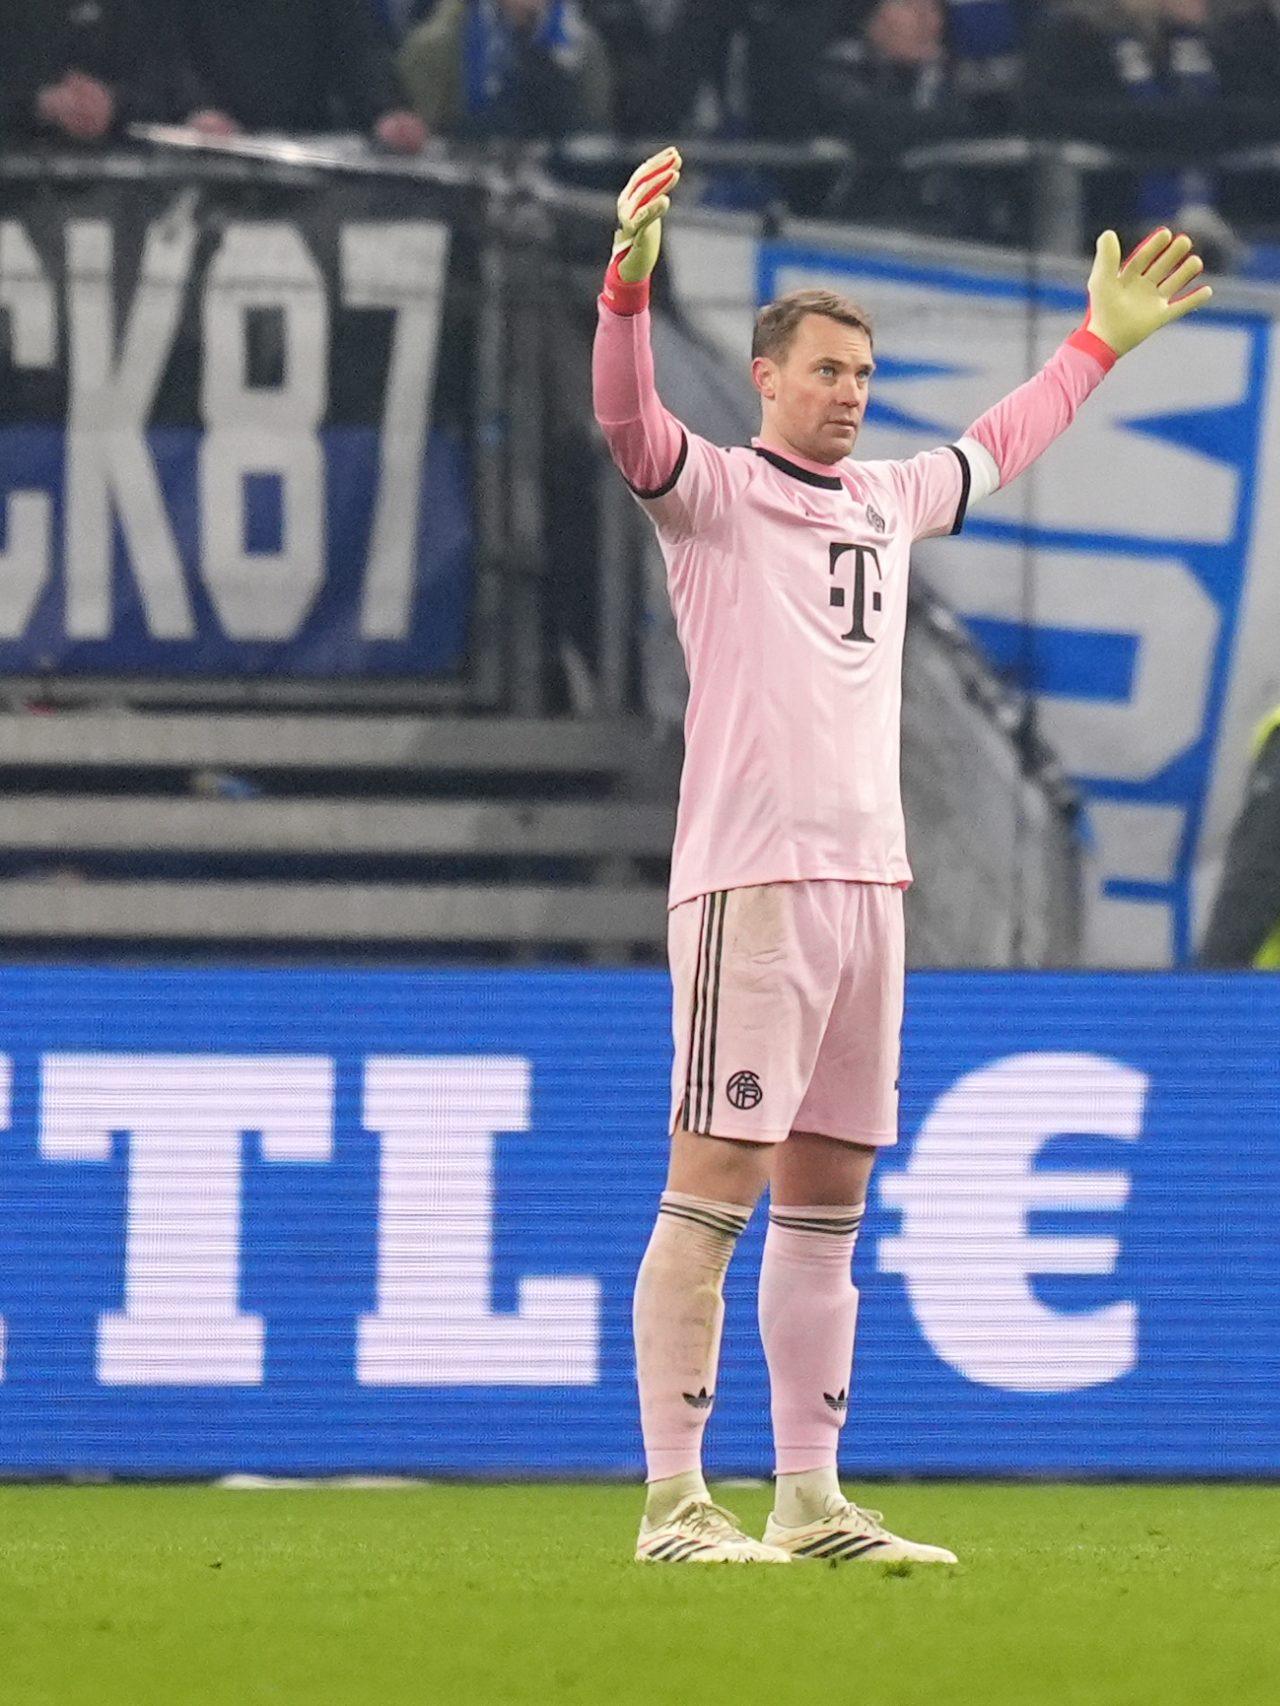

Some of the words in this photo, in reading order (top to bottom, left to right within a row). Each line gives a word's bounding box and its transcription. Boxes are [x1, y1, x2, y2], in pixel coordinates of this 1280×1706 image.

[829, 541, 882, 643] T
[0, 1052, 599, 1387] TL
[876, 1050, 1151, 1393] €
